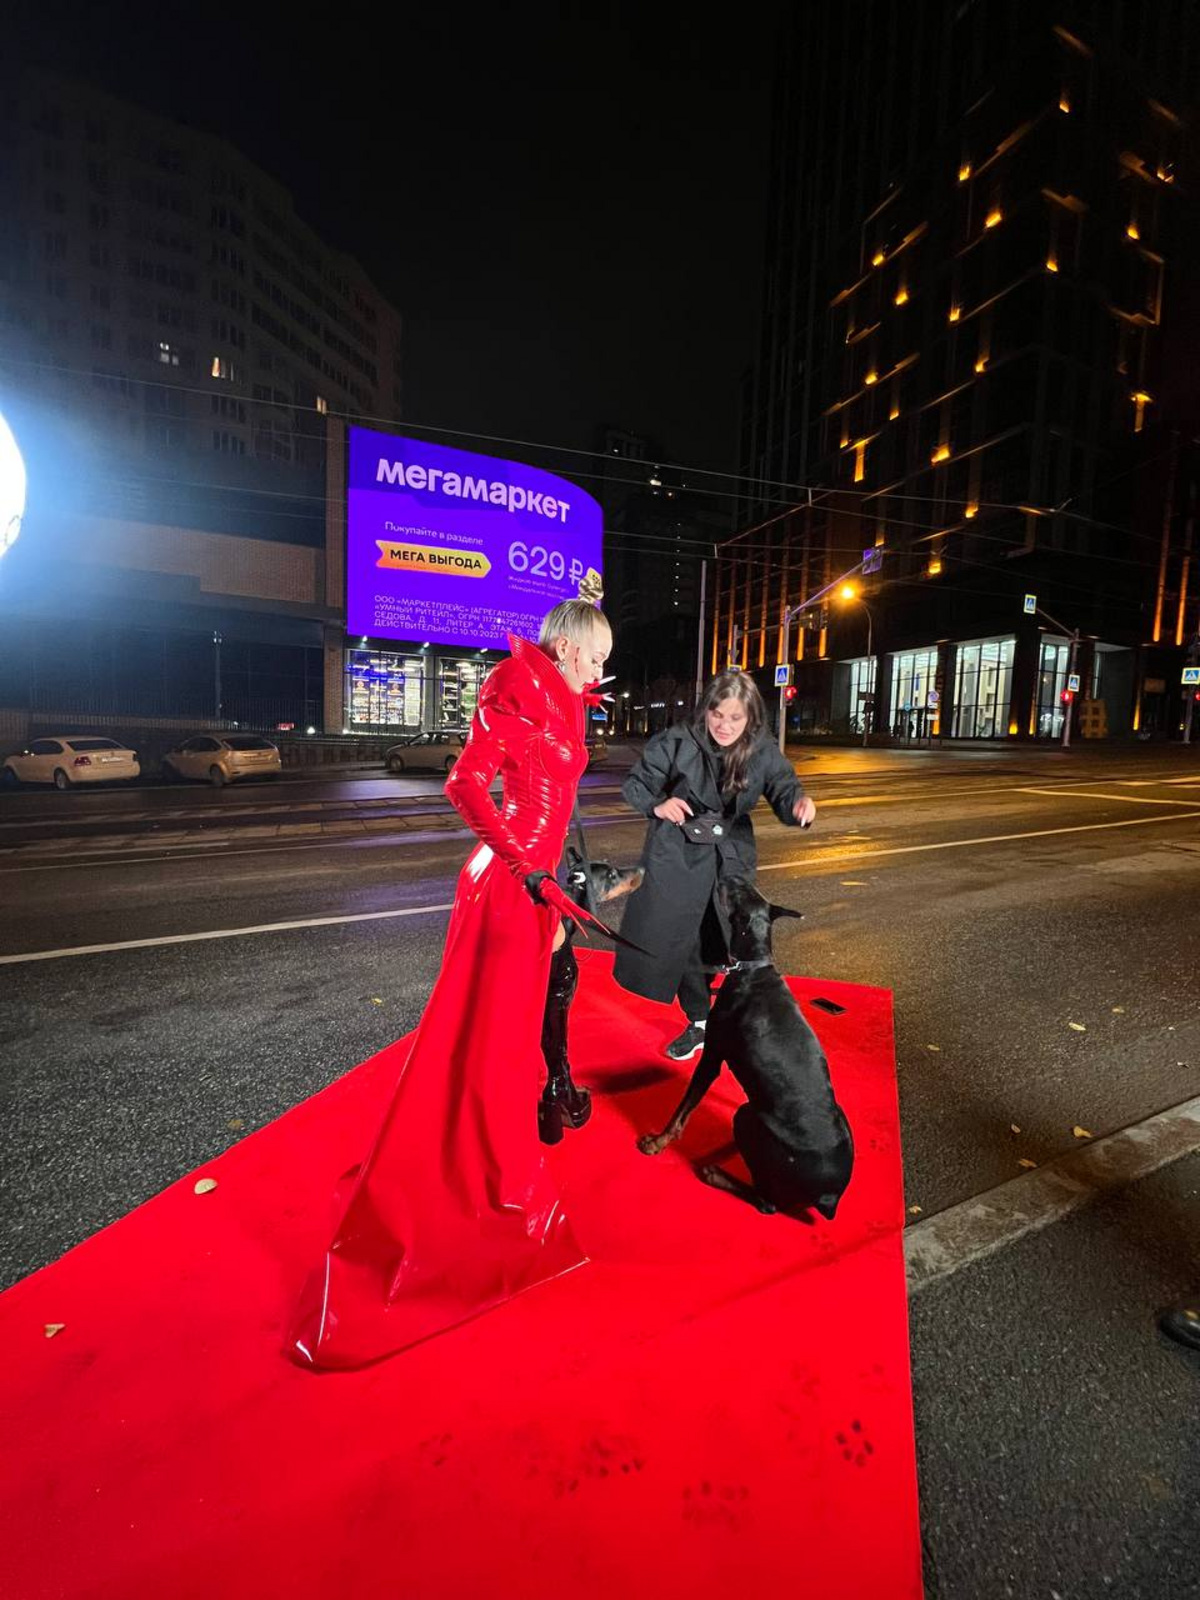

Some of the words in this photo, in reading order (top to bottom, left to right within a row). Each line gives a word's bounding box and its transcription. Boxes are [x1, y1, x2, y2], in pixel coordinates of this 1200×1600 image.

[385, 521, 438, 538] Покупайте
[439, 531, 446, 540] в
[446, 533, 484, 546] разделе
[390, 549, 426, 563] МЕГА
[428, 553, 483, 571] ВЫГОДА
[508, 541, 565, 581] 629
[374, 595, 395, 604] ООО
